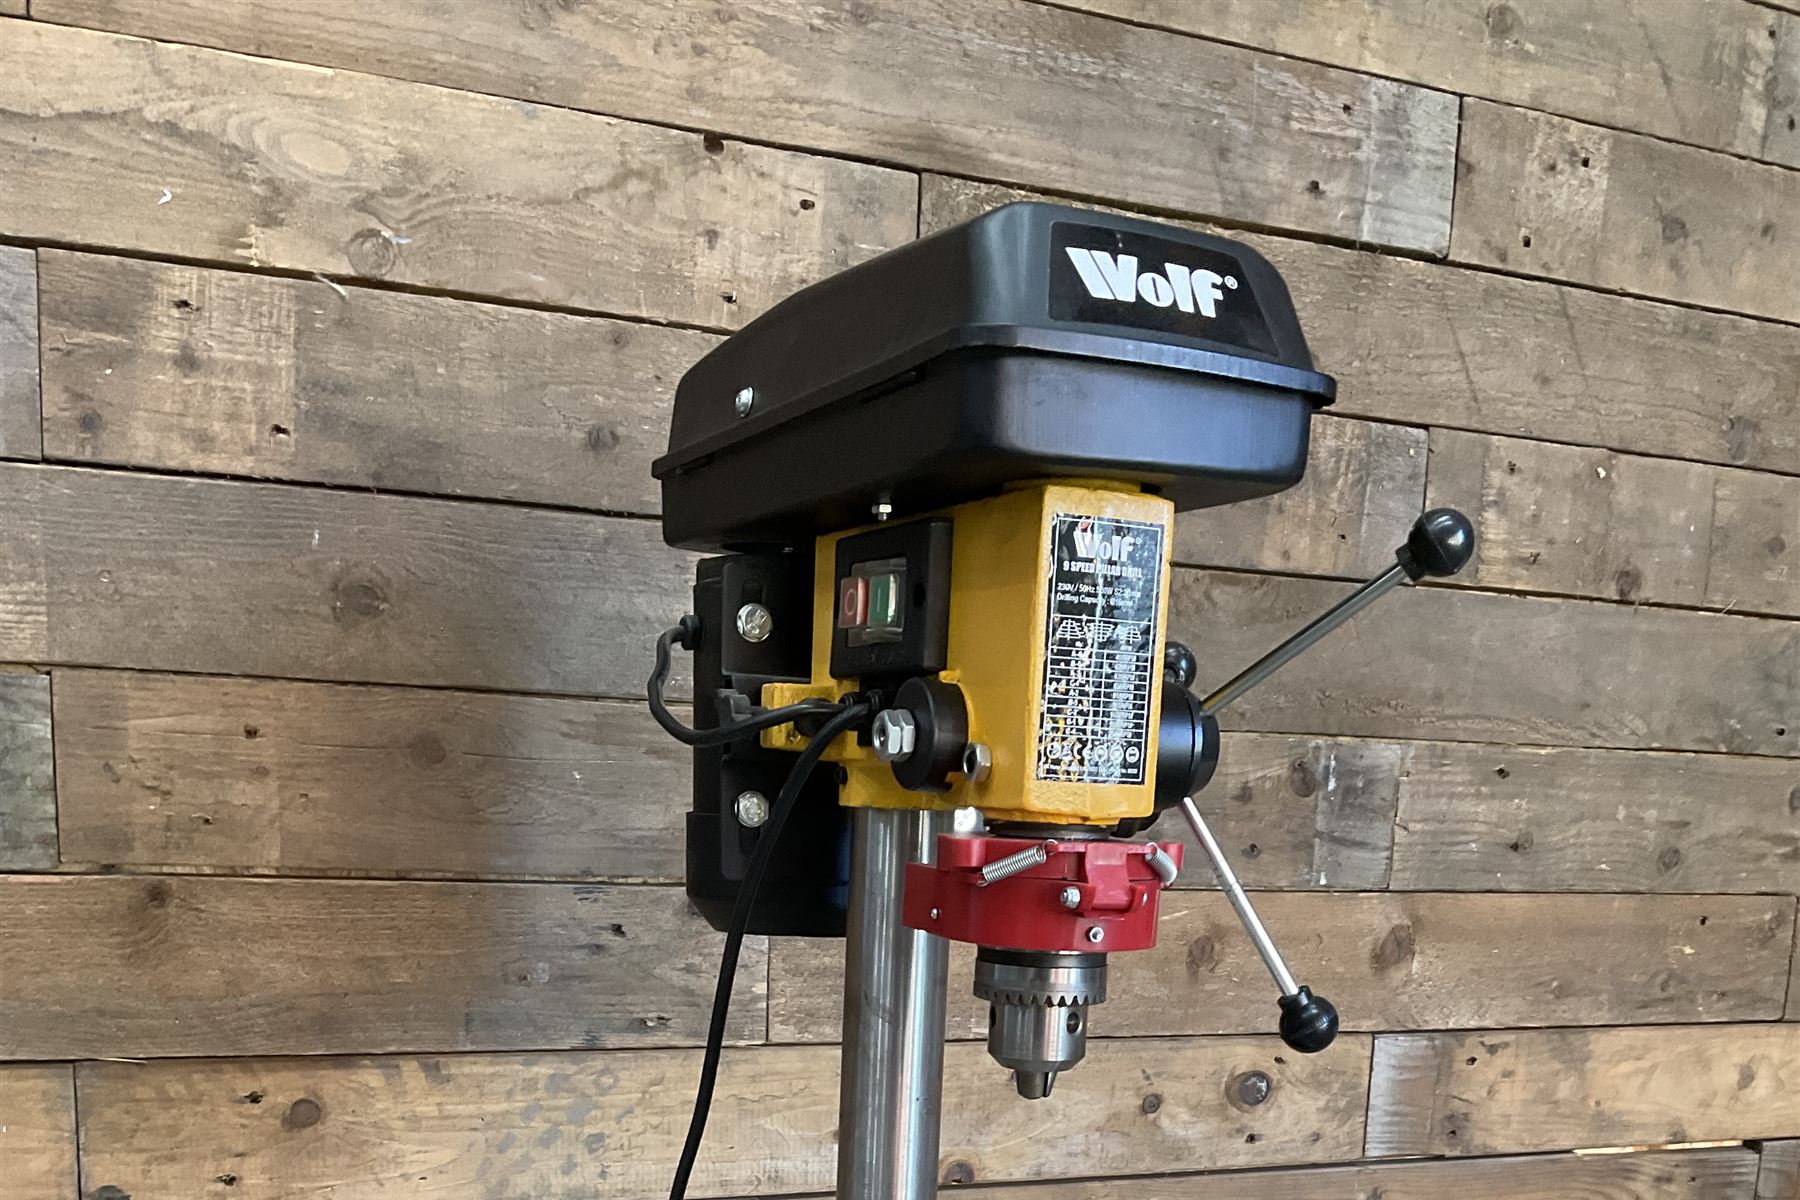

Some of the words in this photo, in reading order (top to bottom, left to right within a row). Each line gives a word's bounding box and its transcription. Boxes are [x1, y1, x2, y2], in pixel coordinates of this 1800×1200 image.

[1070, 561, 1095, 574] SPEED
[1056, 582, 1074, 592] 230V
[1079, 583, 1096, 594] 50Hz
[1096, 585, 1113, 595] 50W
[1056, 592, 1079, 604] Drilling
[1079, 594, 1106, 606] Capacy
